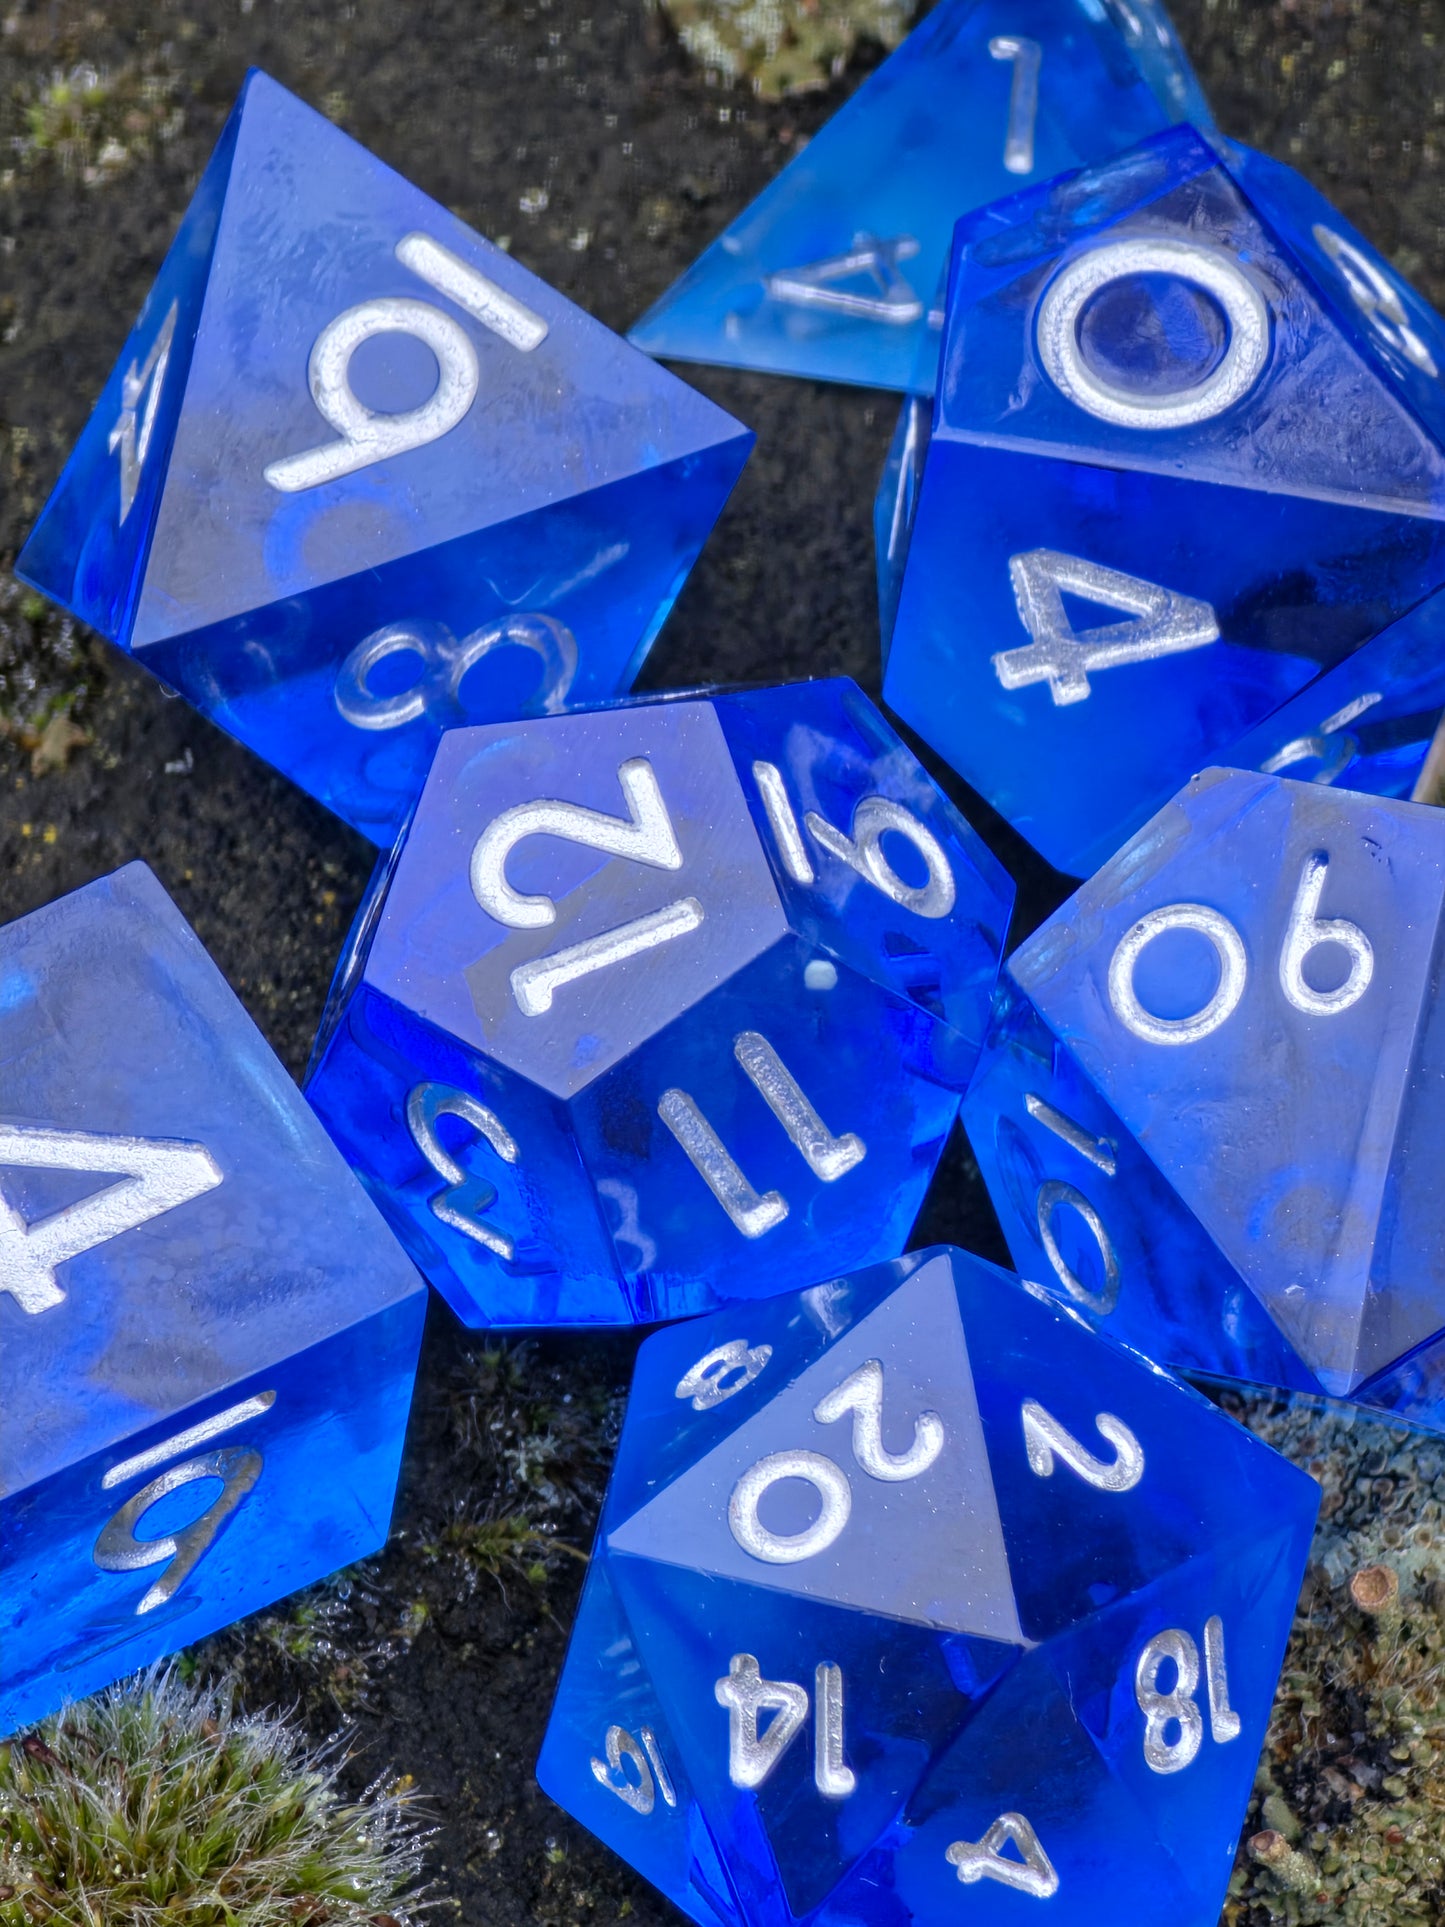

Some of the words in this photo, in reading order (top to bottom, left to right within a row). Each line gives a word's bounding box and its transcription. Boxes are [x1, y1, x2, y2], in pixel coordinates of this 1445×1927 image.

[765, 231, 922, 324] 4
[1037, 238, 1271, 429] 0
[335, 613, 578, 731] 8
[992, 548, 1220, 706] 4
[470, 757, 704, 1016] 12
[657, 1031, 867, 1239] 11
[1024, 1092, 1121, 1315] 10
[0, 1124, 223, 1316] 4
[675, 1339, 773, 1410] 8
[1021, 1400, 1145, 1492] 2
[728, 1358, 944, 1564] 20
[715, 1653, 857, 1798] 14
[1136, 1615, 1240, 1775] 18
[946, 1811, 1059, 1898] 4
